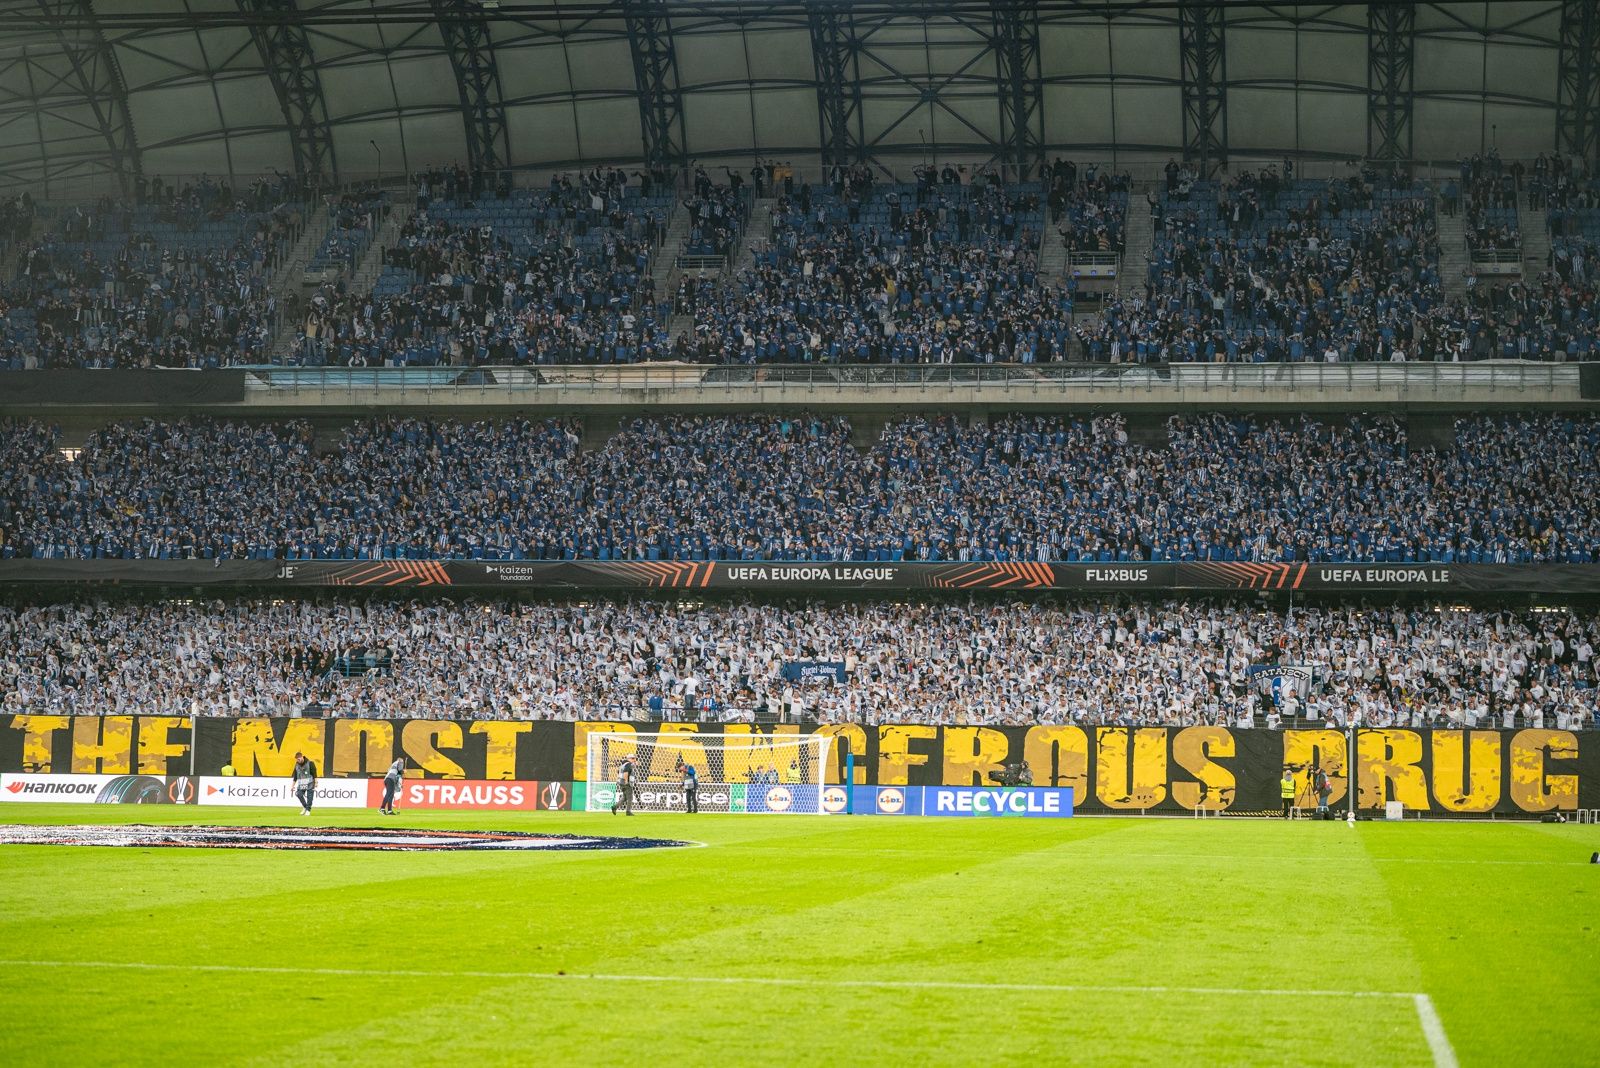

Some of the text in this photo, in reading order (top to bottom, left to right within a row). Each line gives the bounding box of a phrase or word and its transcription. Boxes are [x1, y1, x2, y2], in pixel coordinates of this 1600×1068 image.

[499, 565, 533, 574] kaizen
[728, 568, 768, 580] UEFA
[771, 568, 832, 580] EUROPA
[1321, 570, 1363, 582] UEFA
[1366, 570, 1429, 582] EUROPA
[1253, 667, 1310, 681] RATAJSCY
[1282, 728, 1579, 812] DRUG
[228, 785, 279, 798] kaizen
[409, 785, 525, 806] STRAUSS
[937, 791, 1060, 812] RECYCLE
